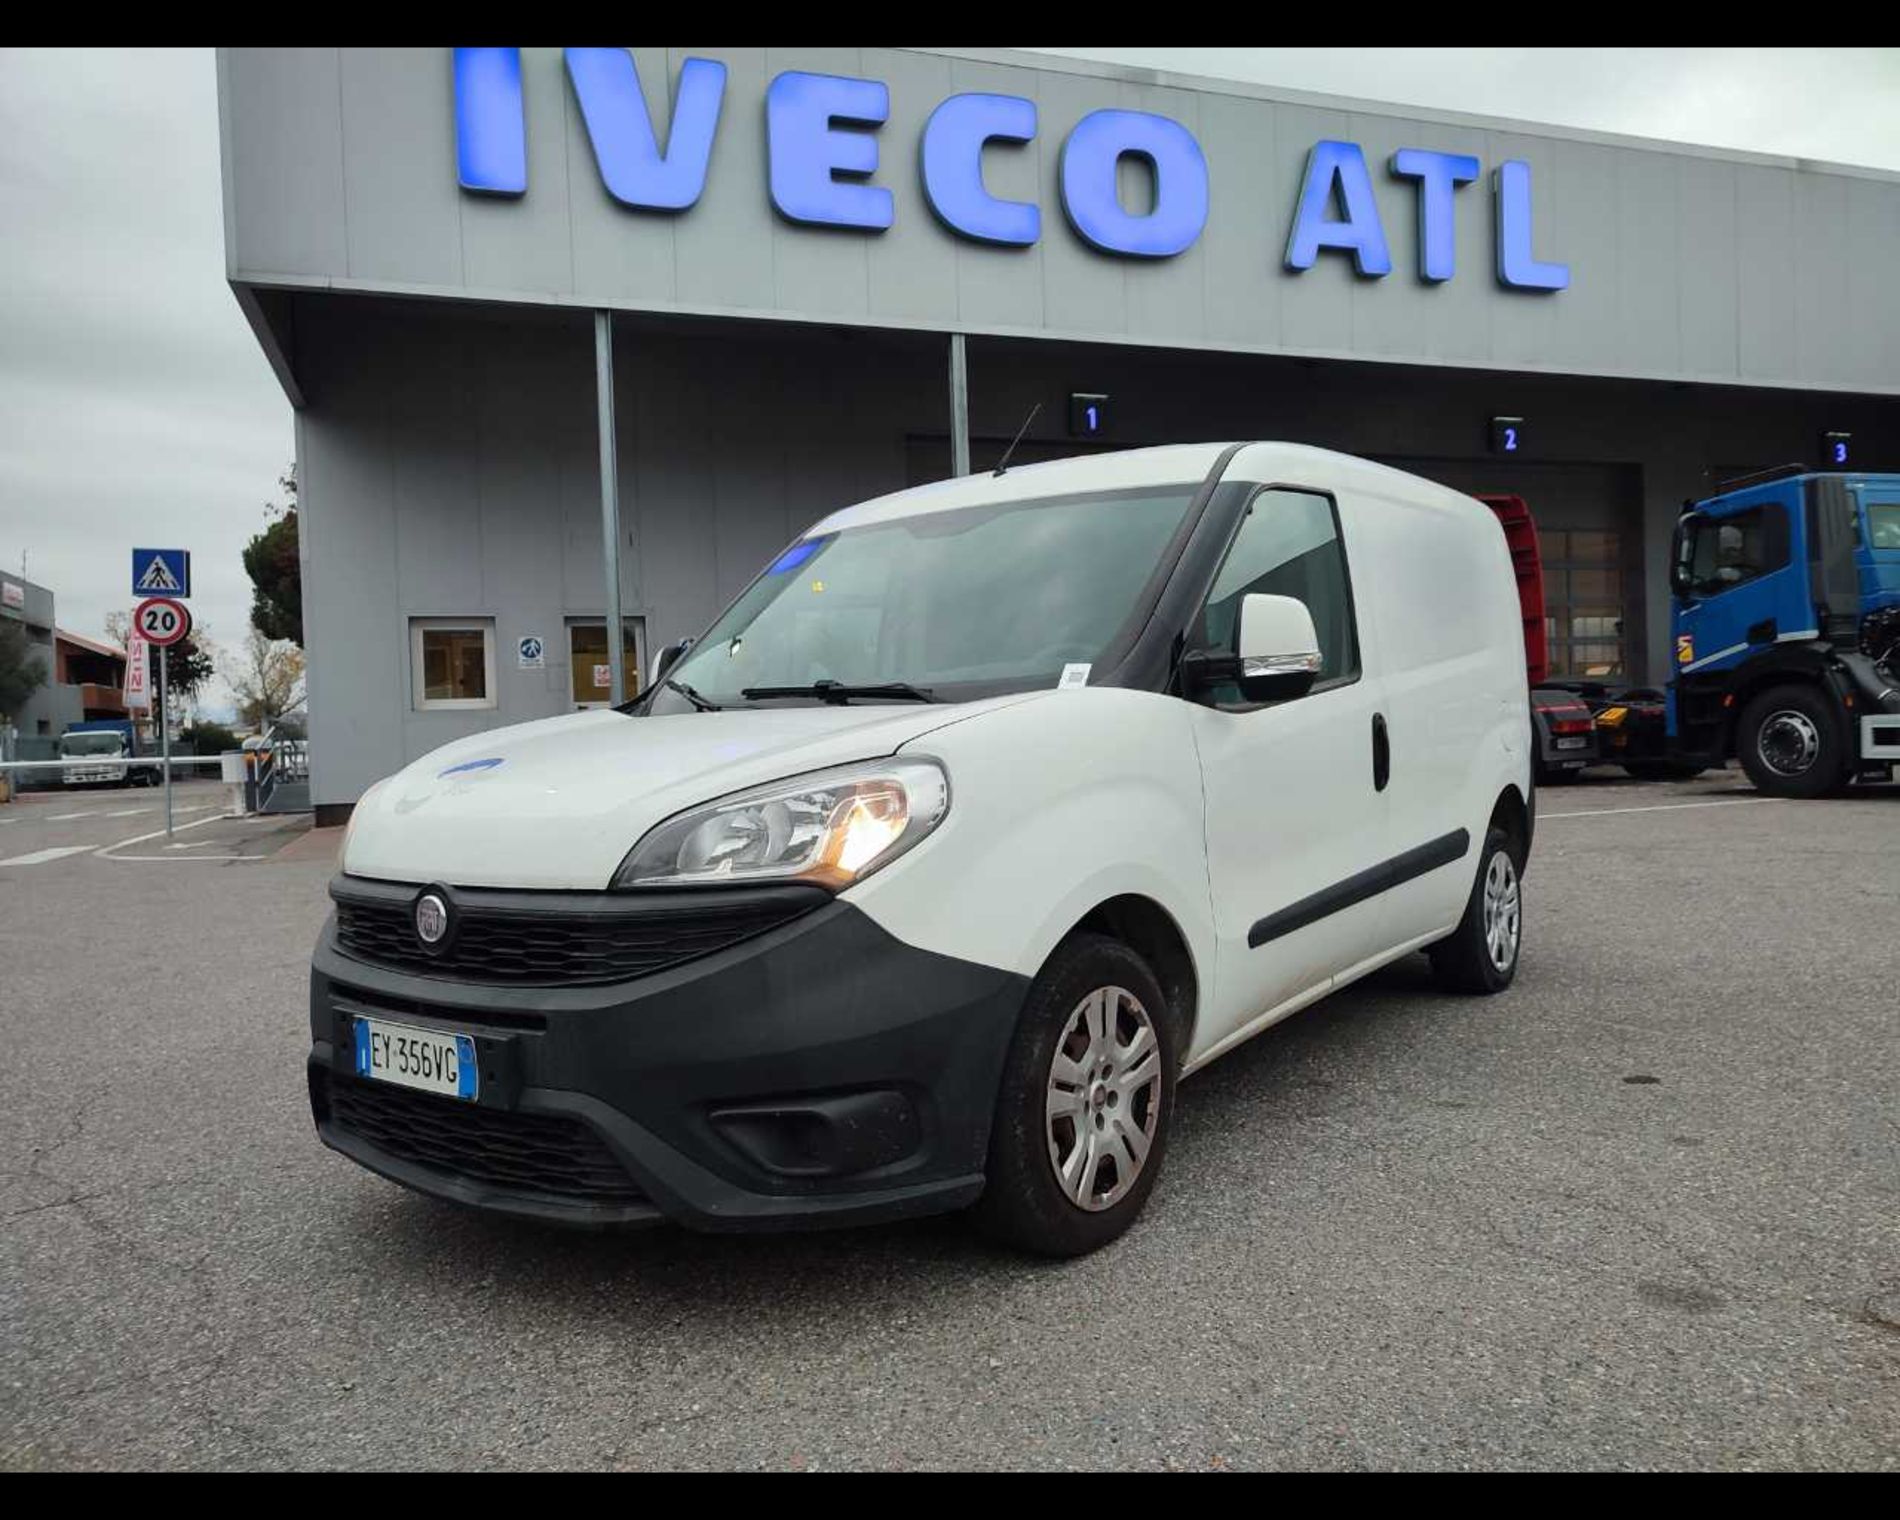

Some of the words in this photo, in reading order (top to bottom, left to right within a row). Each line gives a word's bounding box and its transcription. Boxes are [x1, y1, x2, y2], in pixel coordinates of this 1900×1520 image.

[454, 48, 1209, 257] IVECO
[1285, 140, 1570, 290] ATL
[1087, 408, 1096, 430] 1
[1505, 429, 1517, 450] 2
[1836, 443, 1847, 462] 3
[145, 610, 176, 631] 20
